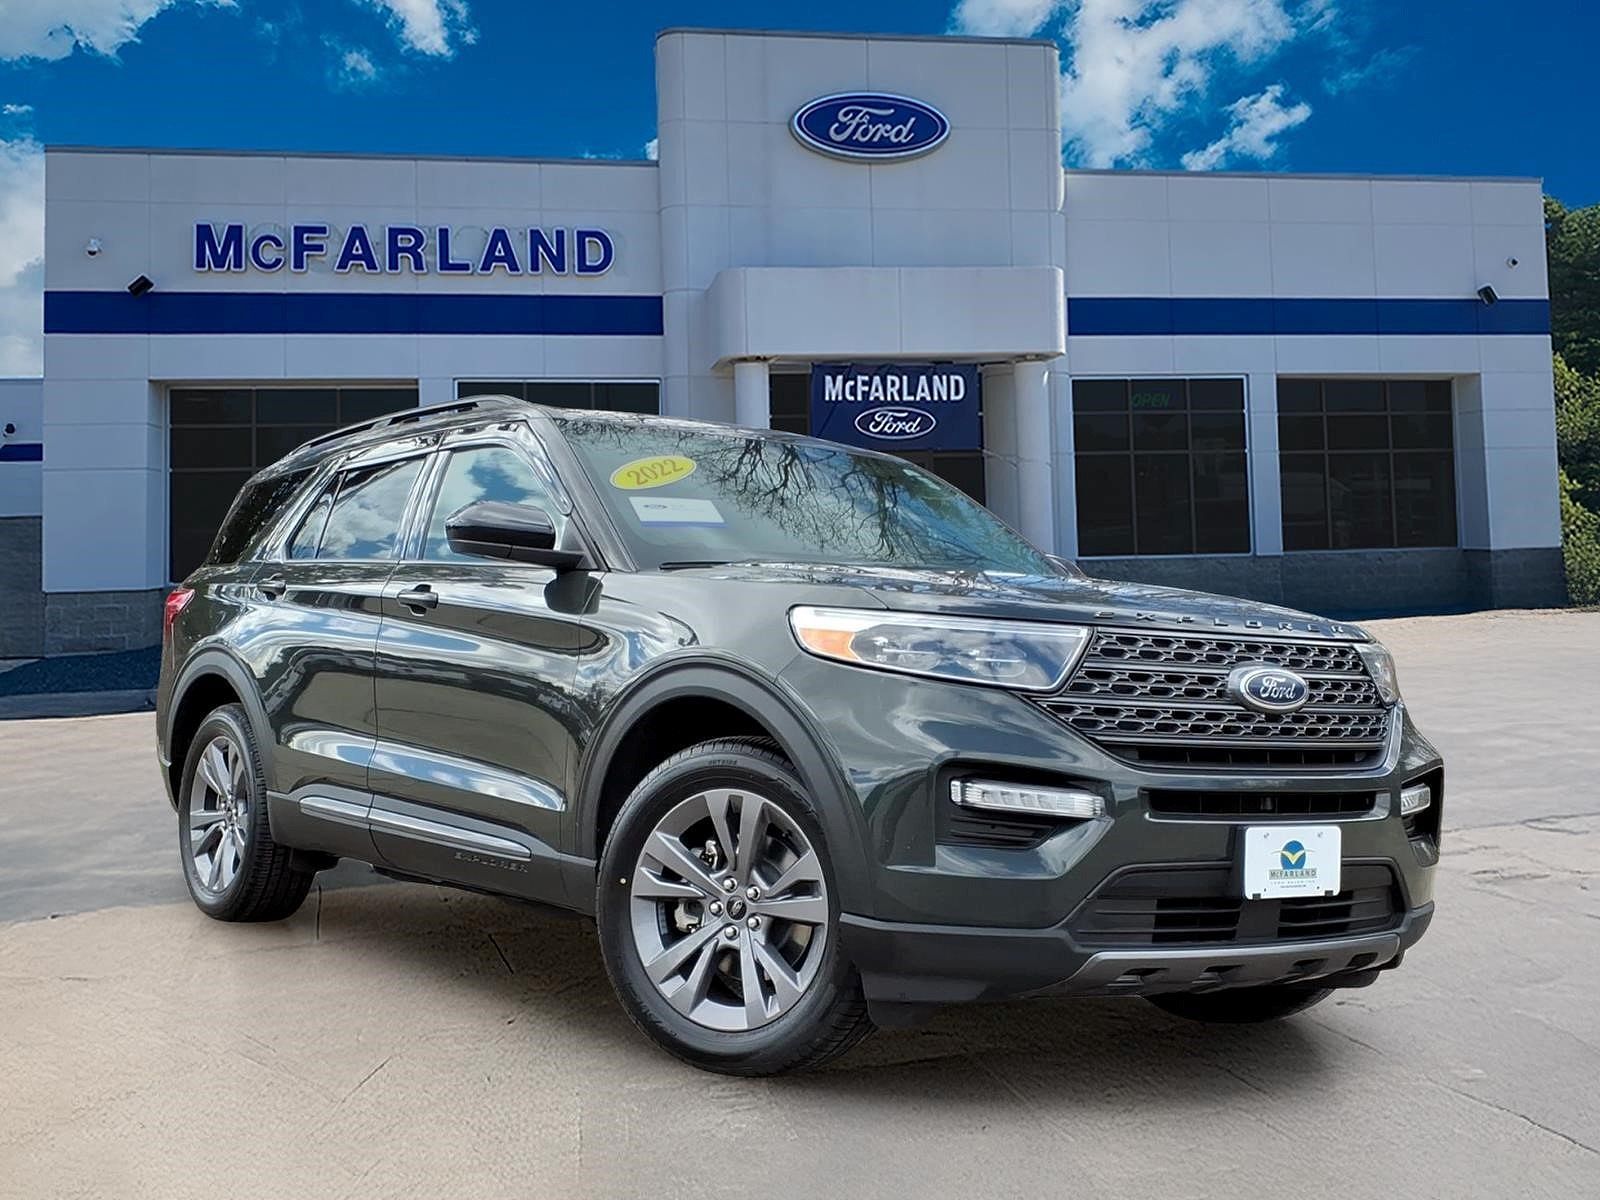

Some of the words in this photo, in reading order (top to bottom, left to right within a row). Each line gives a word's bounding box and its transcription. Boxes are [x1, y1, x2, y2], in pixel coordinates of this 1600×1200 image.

[829, 105, 916, 143] Ford
[194, 222, 615, 276] McFARLAND
[824, 375, 966, 401] McFARLAND
[868, 410, 922, 433] Ford
[627, 459, 684, 485] 2022
[1093, 611, 1345, 634] EXPLORER
[1260, 675, 1296, 700] Ford
